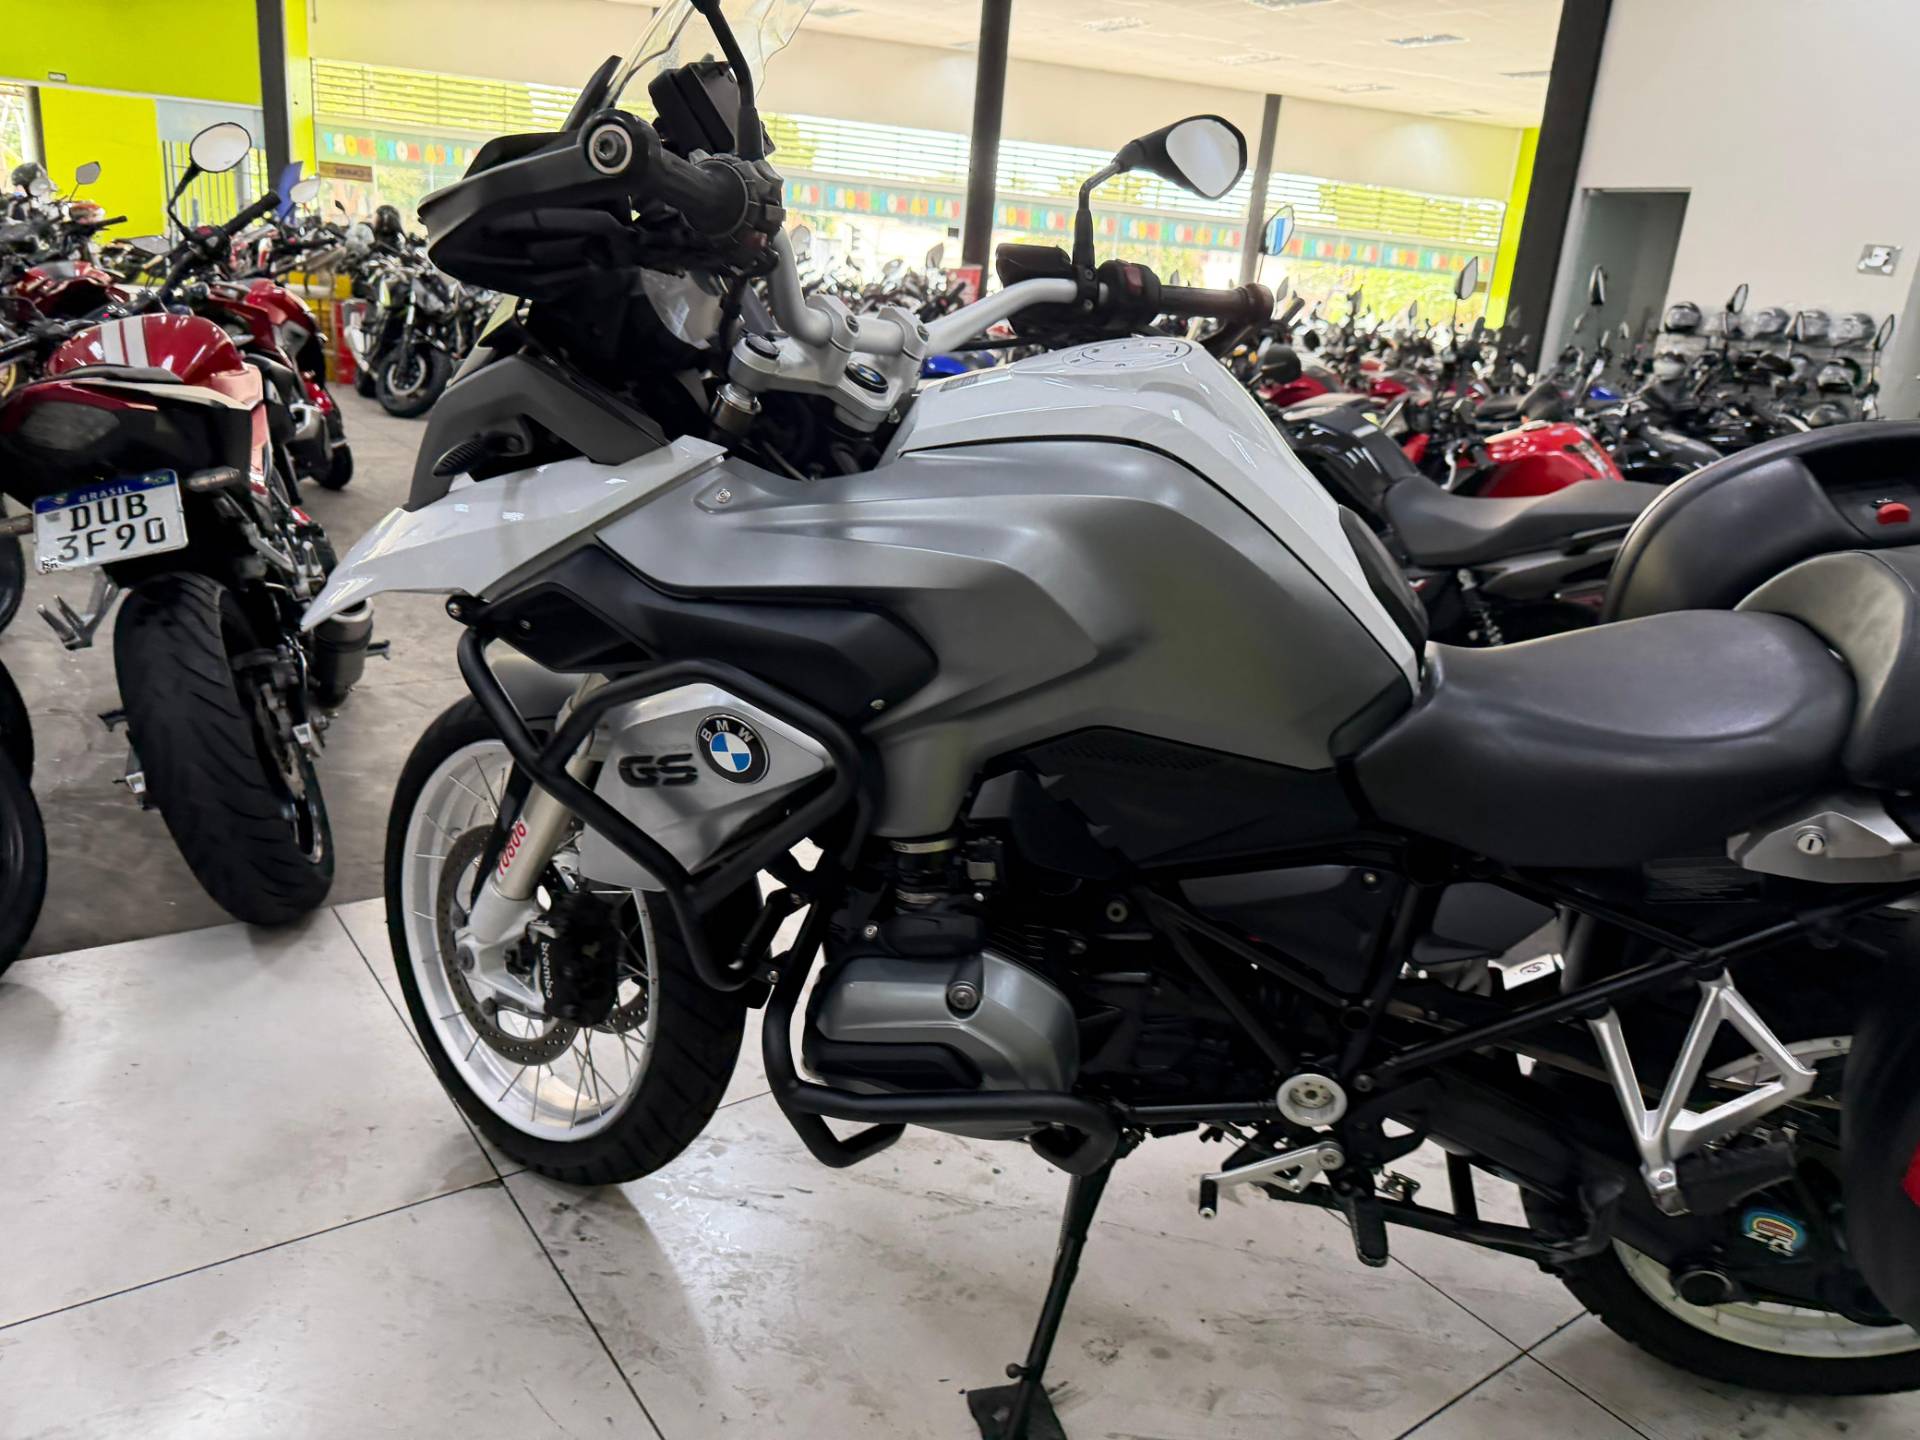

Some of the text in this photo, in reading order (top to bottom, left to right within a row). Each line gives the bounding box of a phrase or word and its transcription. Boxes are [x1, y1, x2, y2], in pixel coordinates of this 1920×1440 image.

[69, 493, 148, 532] DUB
[79, 485, 132, 503] BRASIL
[56, 517, 167, 563] 3F90
[700, 719, 754, 743] BMW
[618, 753, 698, 788] GS
[540, 942, 554, 999] brembo
